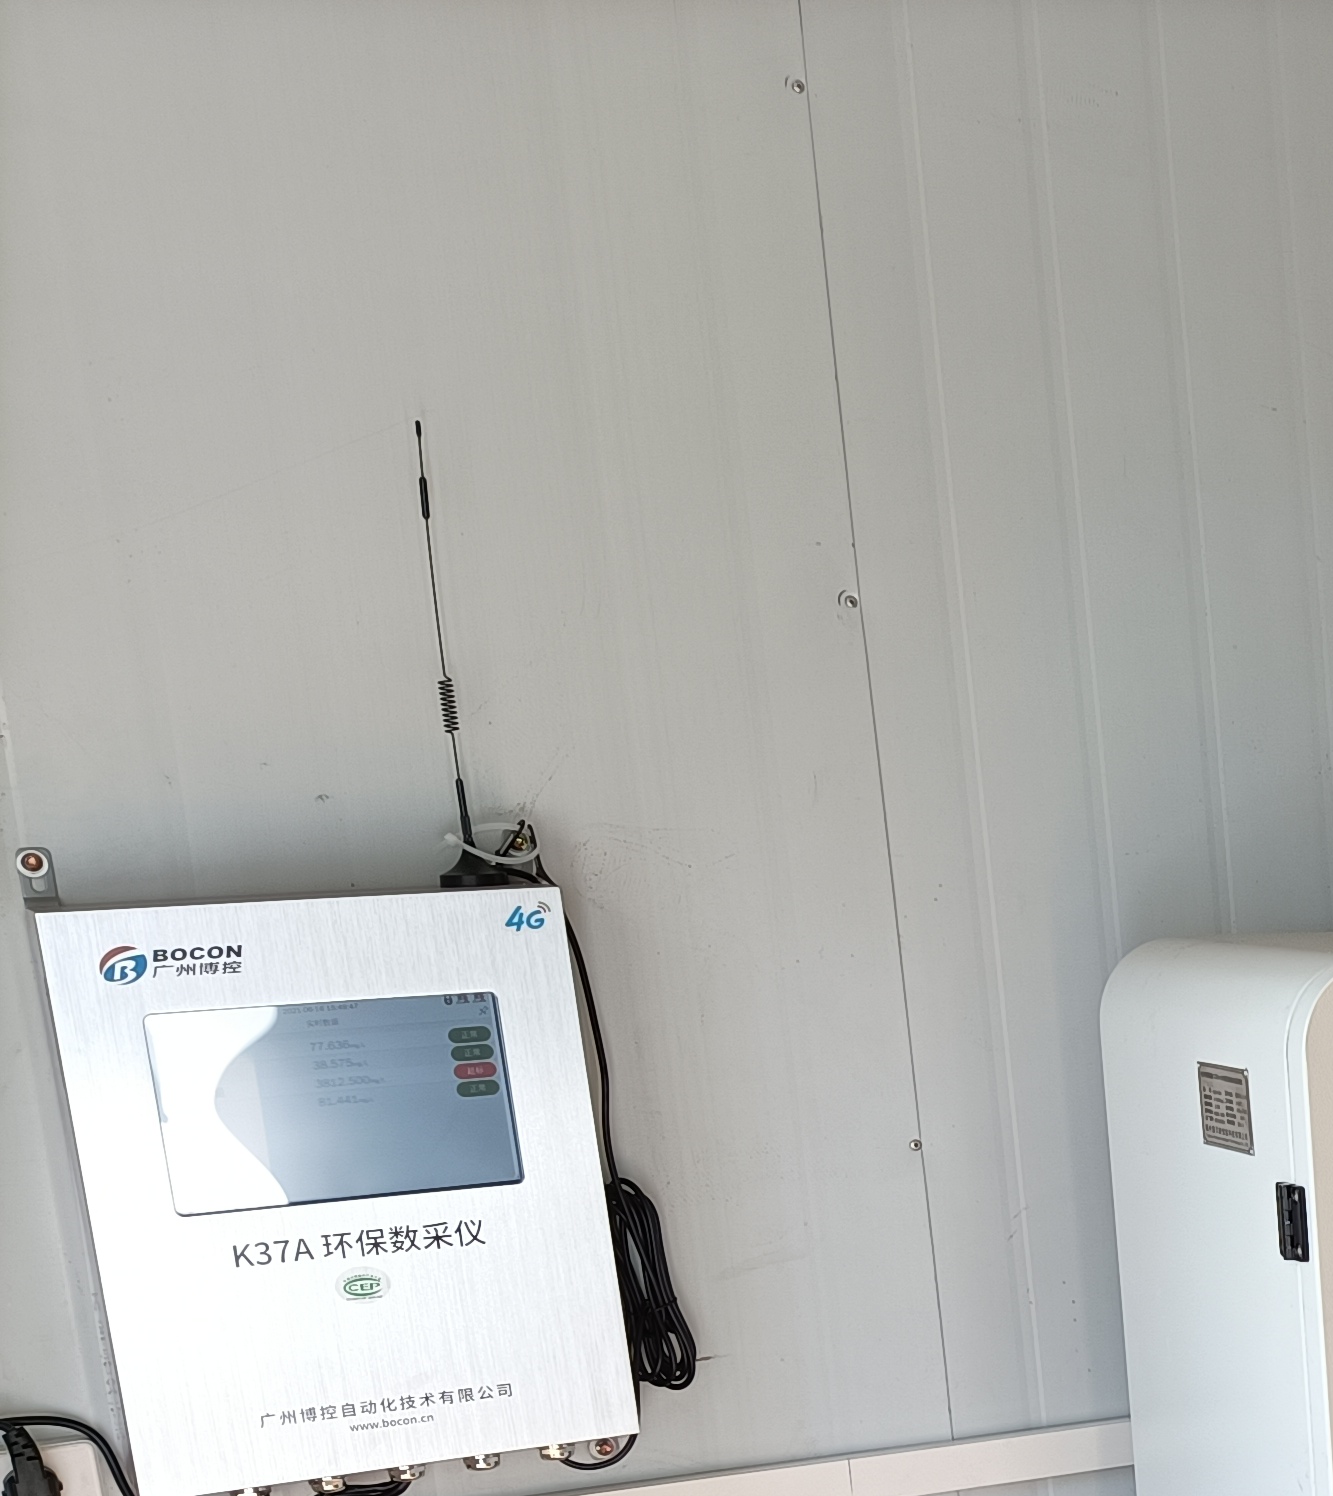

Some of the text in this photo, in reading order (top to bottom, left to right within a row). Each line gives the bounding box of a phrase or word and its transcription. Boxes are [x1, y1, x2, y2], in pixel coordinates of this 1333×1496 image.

[505, 905, 545, 932] 4G
[152, 945, 242, 962] BOCON
[152, 961, 242, 978] 广州博控
[232, 1219, 486, 1268] K37A 环保数采仪
[260, 1383, 513, 1429] 广州博控自动化技术有限公司
[349, 1414, 435, 1432] www.bocon.cn
